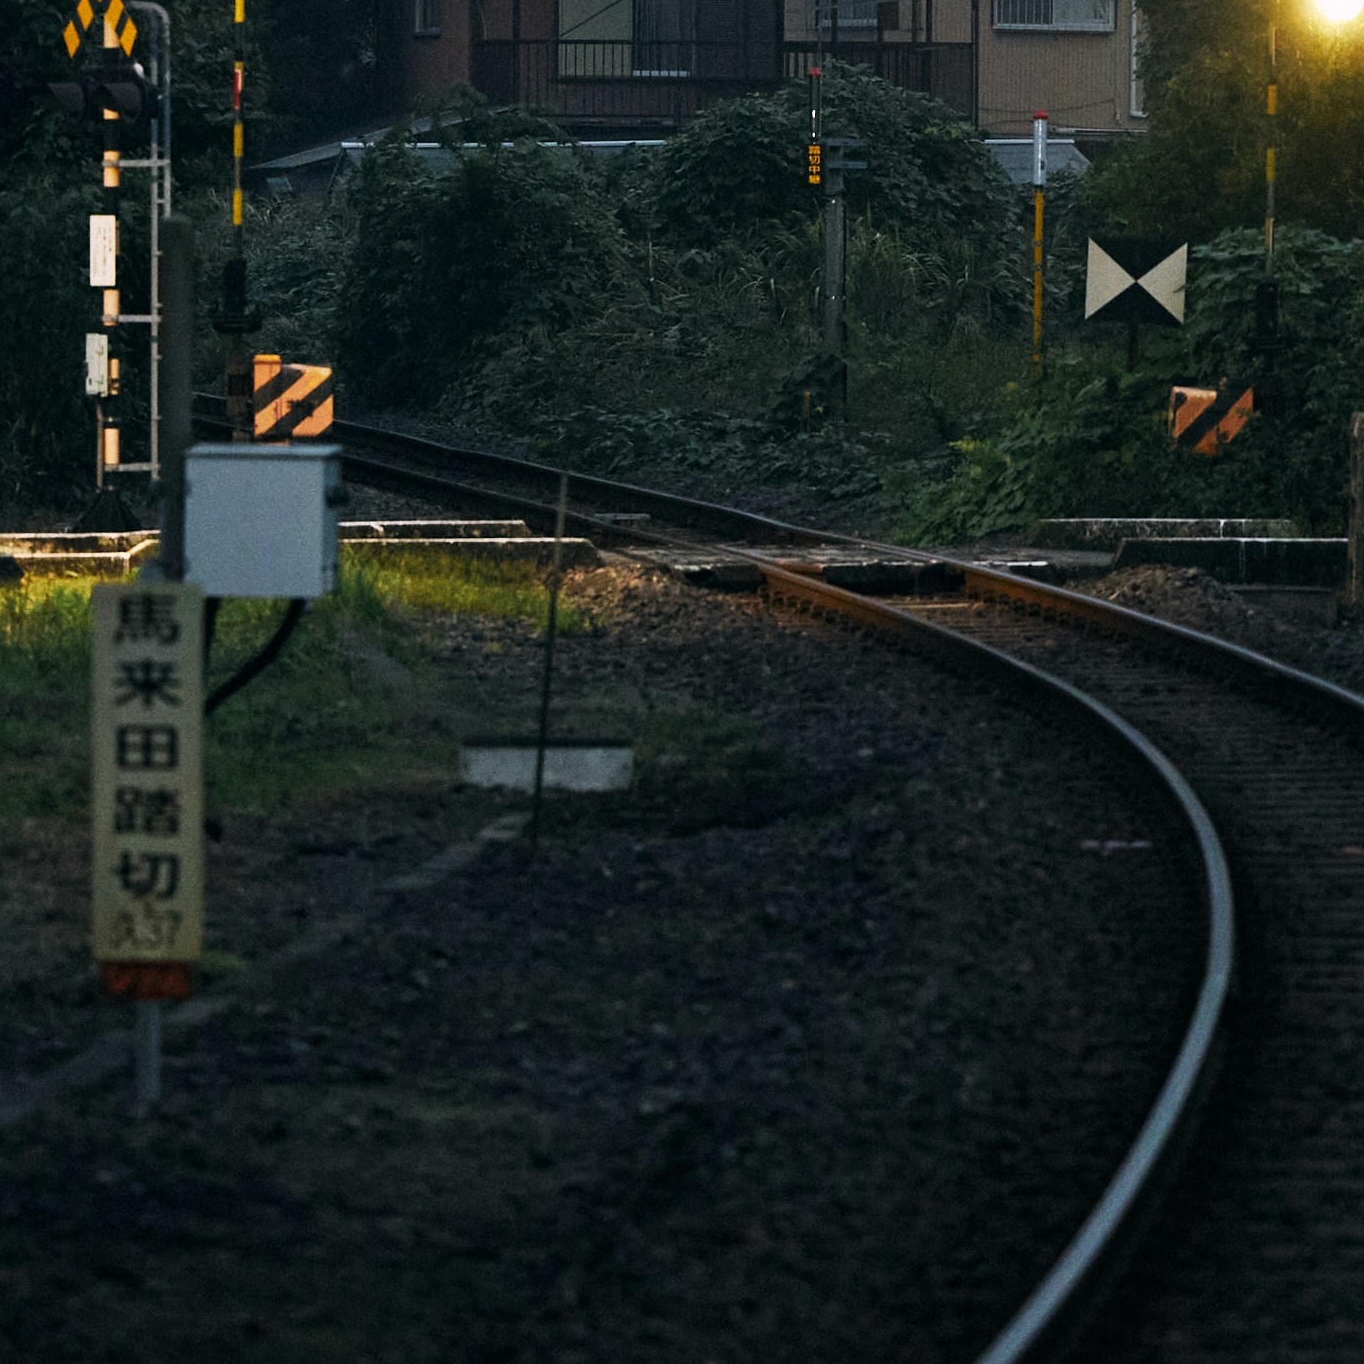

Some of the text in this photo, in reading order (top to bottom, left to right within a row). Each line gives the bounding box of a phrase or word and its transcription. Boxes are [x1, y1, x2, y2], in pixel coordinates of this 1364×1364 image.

[113, 593, 181, 899] 馬来田踏切
